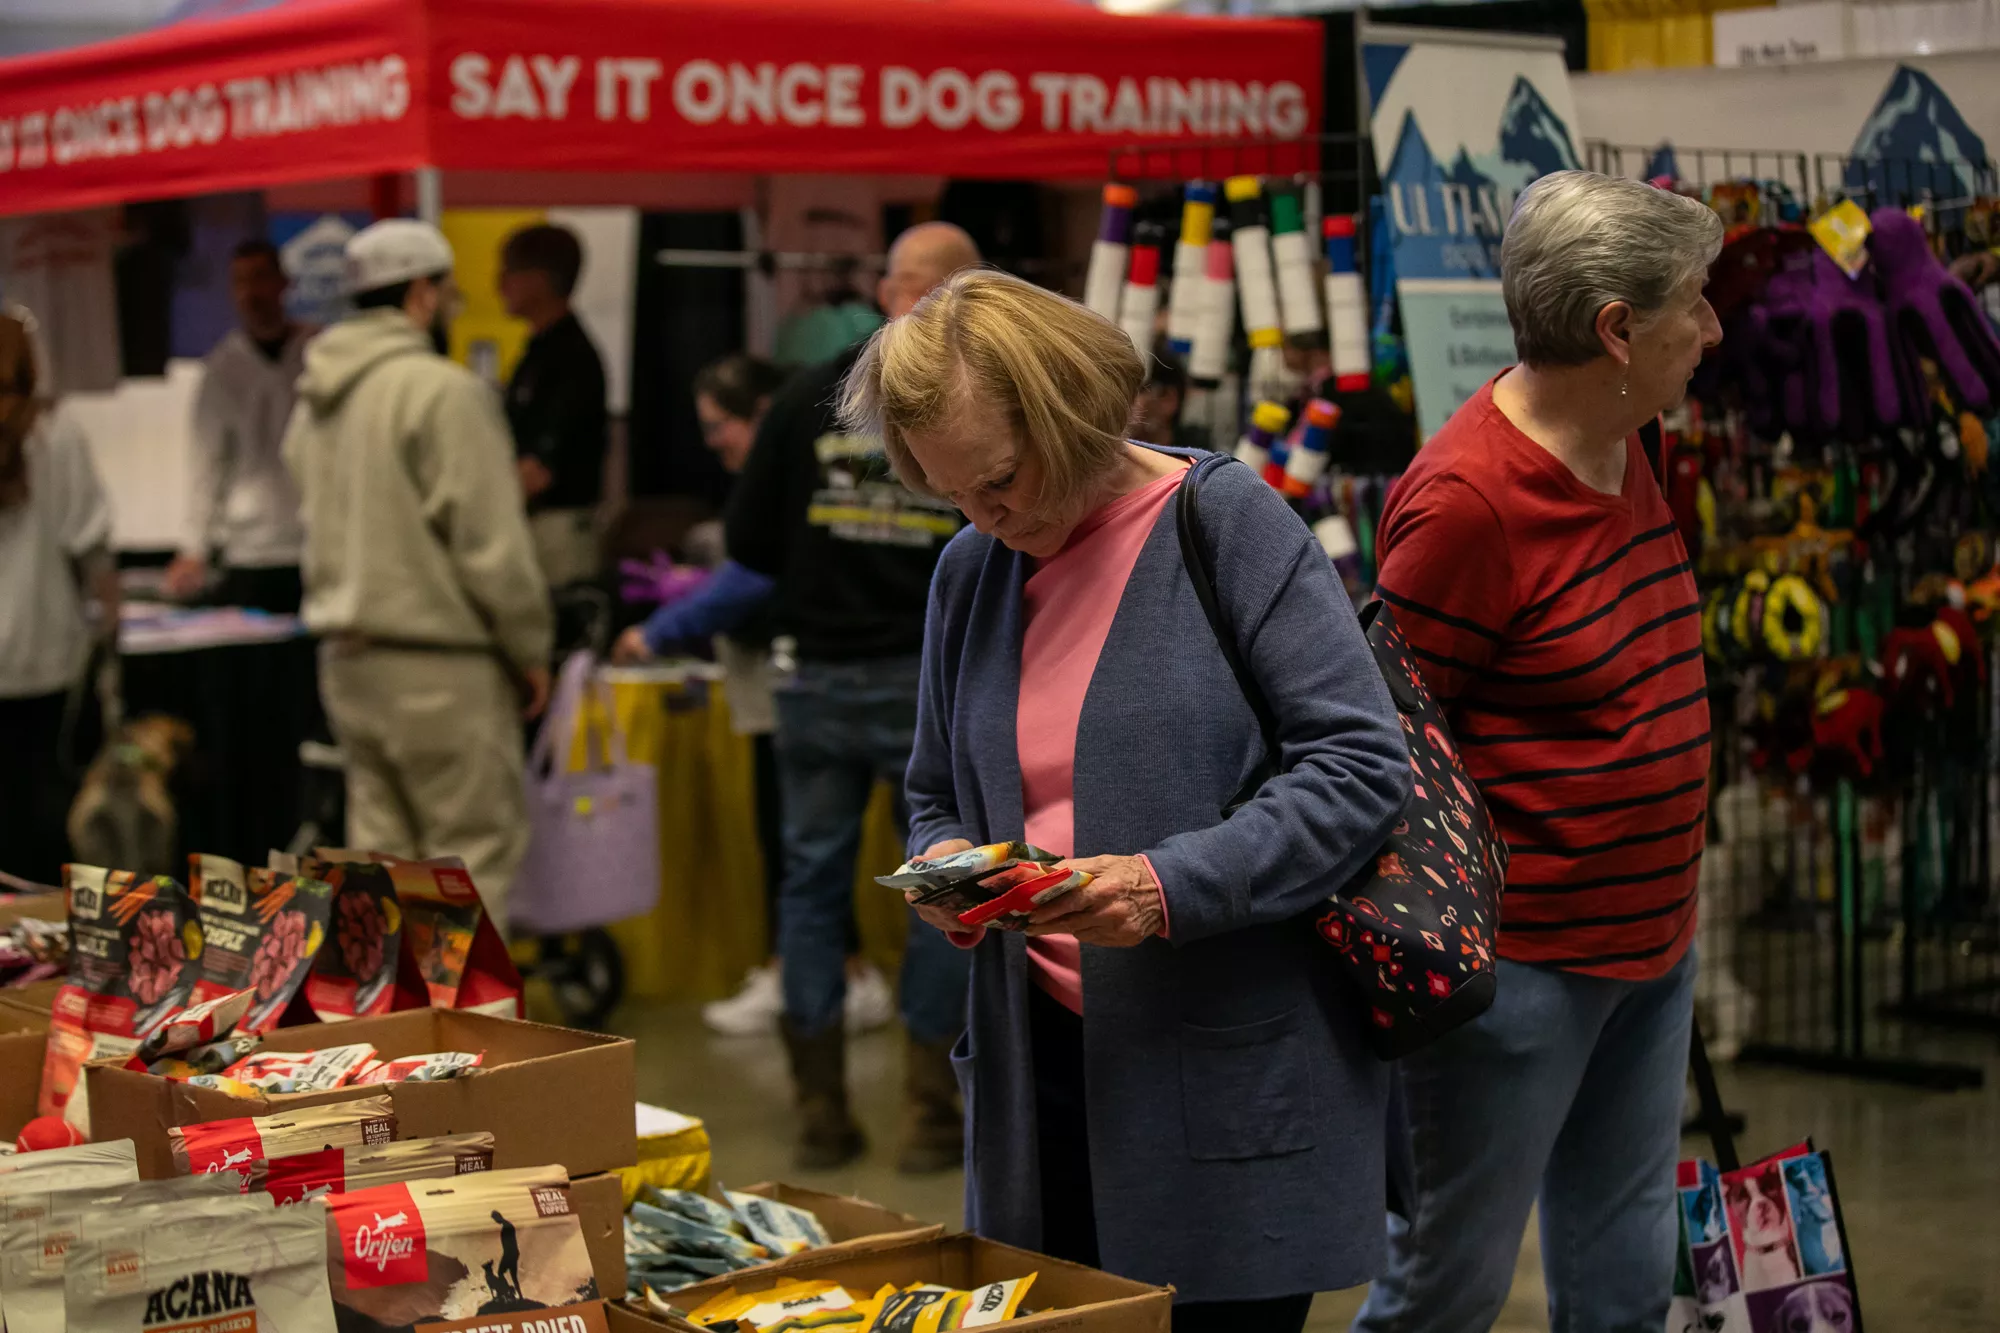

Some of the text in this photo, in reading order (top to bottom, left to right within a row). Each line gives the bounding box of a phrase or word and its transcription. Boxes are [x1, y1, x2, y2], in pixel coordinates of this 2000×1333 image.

[52, 95, 142, 165] ONCE
[143, 81, 226, 152] DOG
[223, 52, 410, 141] TRAINING
[449, 51, 1310, 141] SAY IT ONCE DOG TRAINING
[365, 1122, 391, 1135] MEAL
[459, 1160, 486, 1173] MEAL
[535, 1190, 566, 1202] MEAL
[355, 1224, 414, 1272] Orijen
[107, 1259, 139, 1276] RAW
[142, 1270, 255, 1325] ACANA
